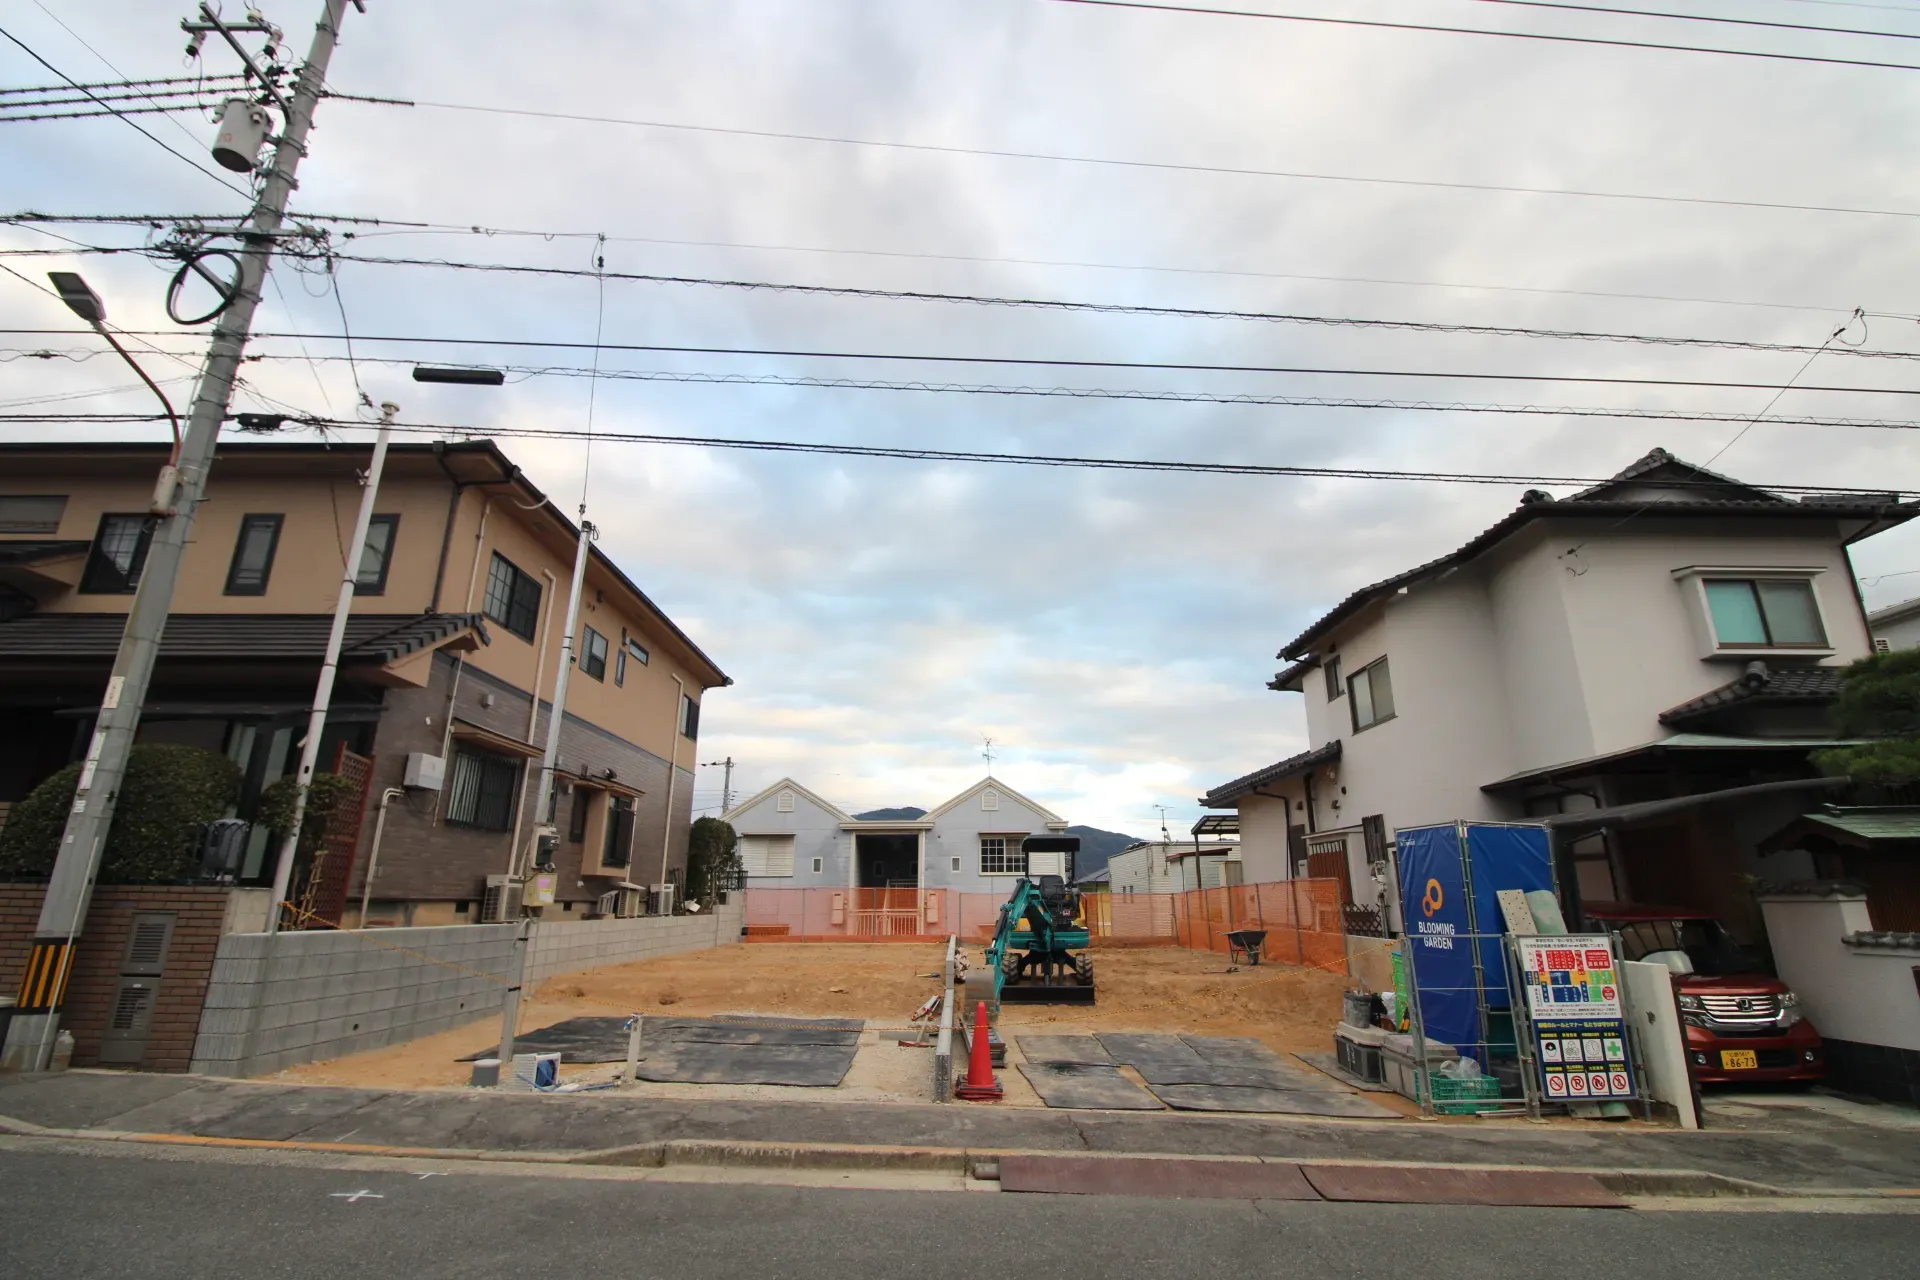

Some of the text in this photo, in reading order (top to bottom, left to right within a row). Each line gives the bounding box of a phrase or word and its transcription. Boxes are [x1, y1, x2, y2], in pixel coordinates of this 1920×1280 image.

[1418, 921, 1455, 936] BLOOMING
[1423, 937, 1453, 950] GARDEN
[1730, 1057, 1756, 1068] 86-73
